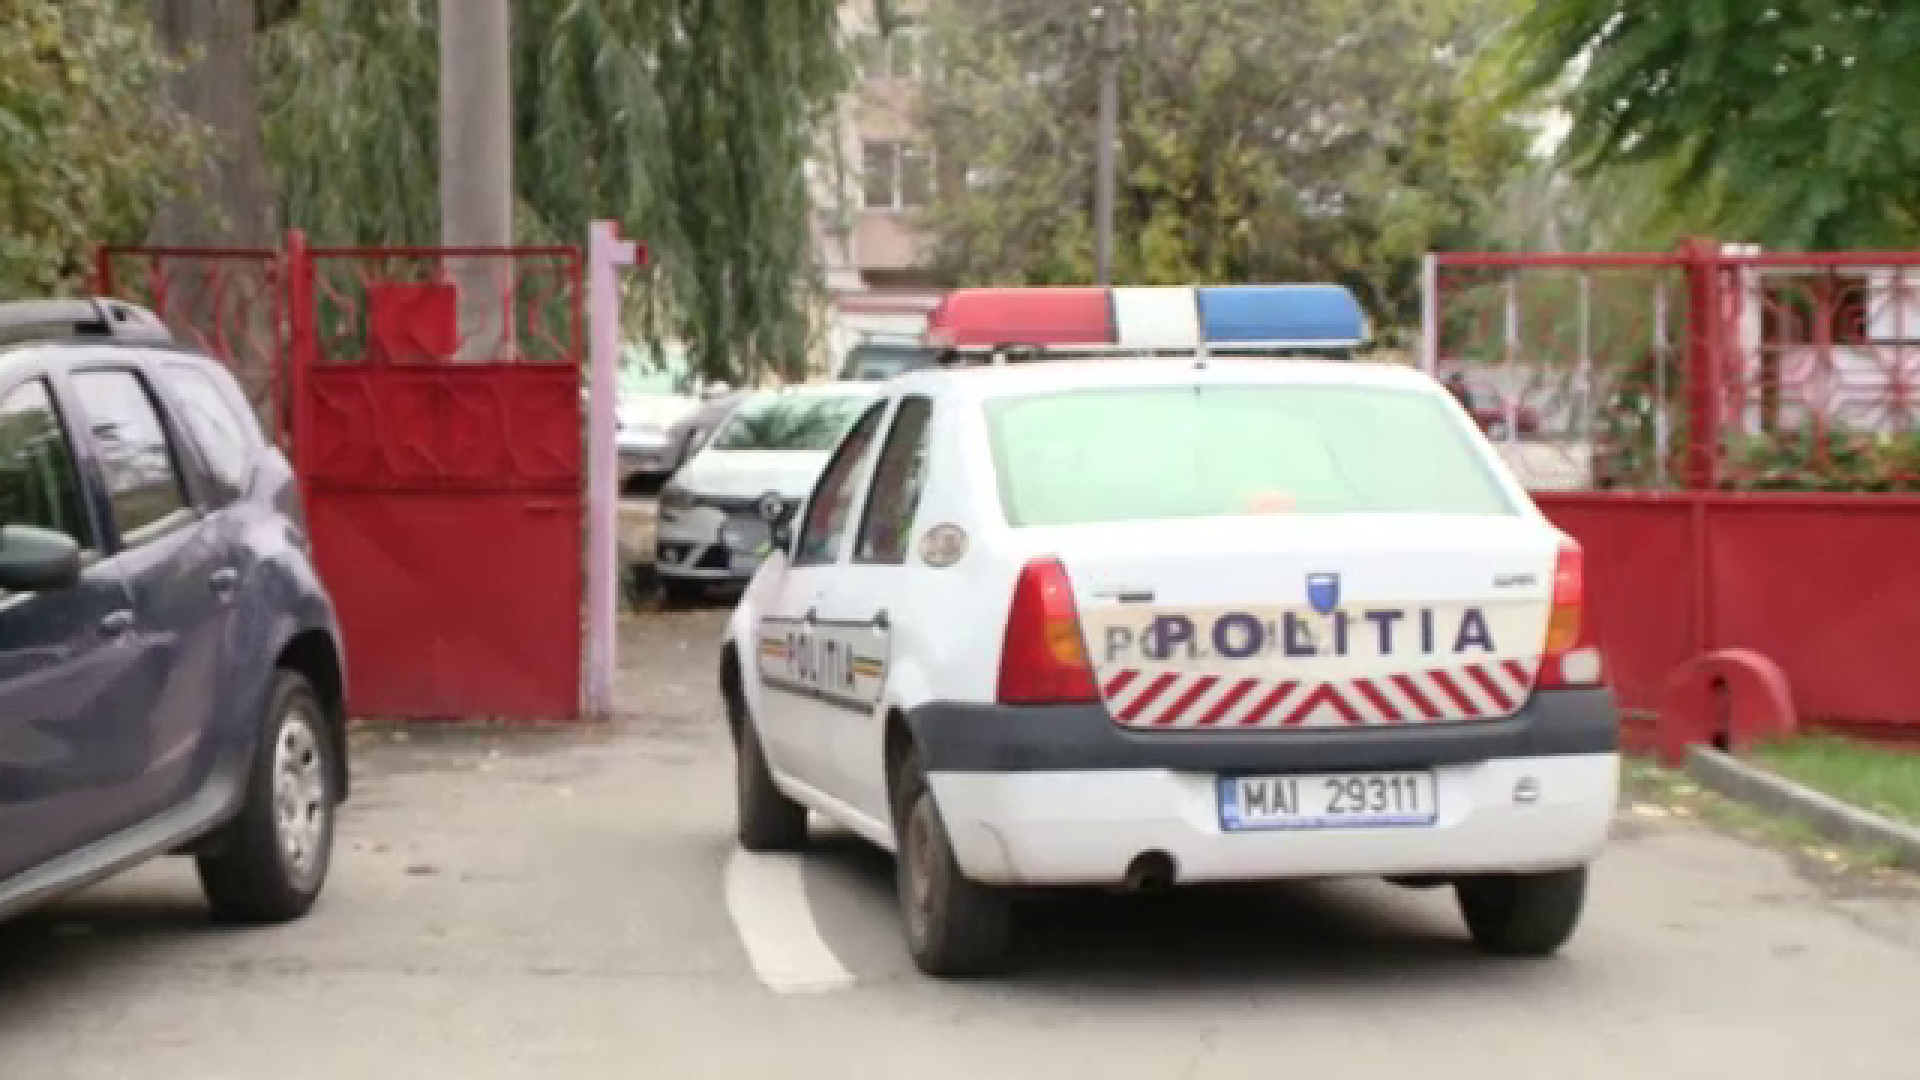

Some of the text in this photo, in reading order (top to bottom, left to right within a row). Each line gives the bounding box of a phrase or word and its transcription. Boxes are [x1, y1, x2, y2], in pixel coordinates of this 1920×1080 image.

[1154, 606, 1497, 660] POLITIA
[1242, 775, 1419, 816] MAI 29311
